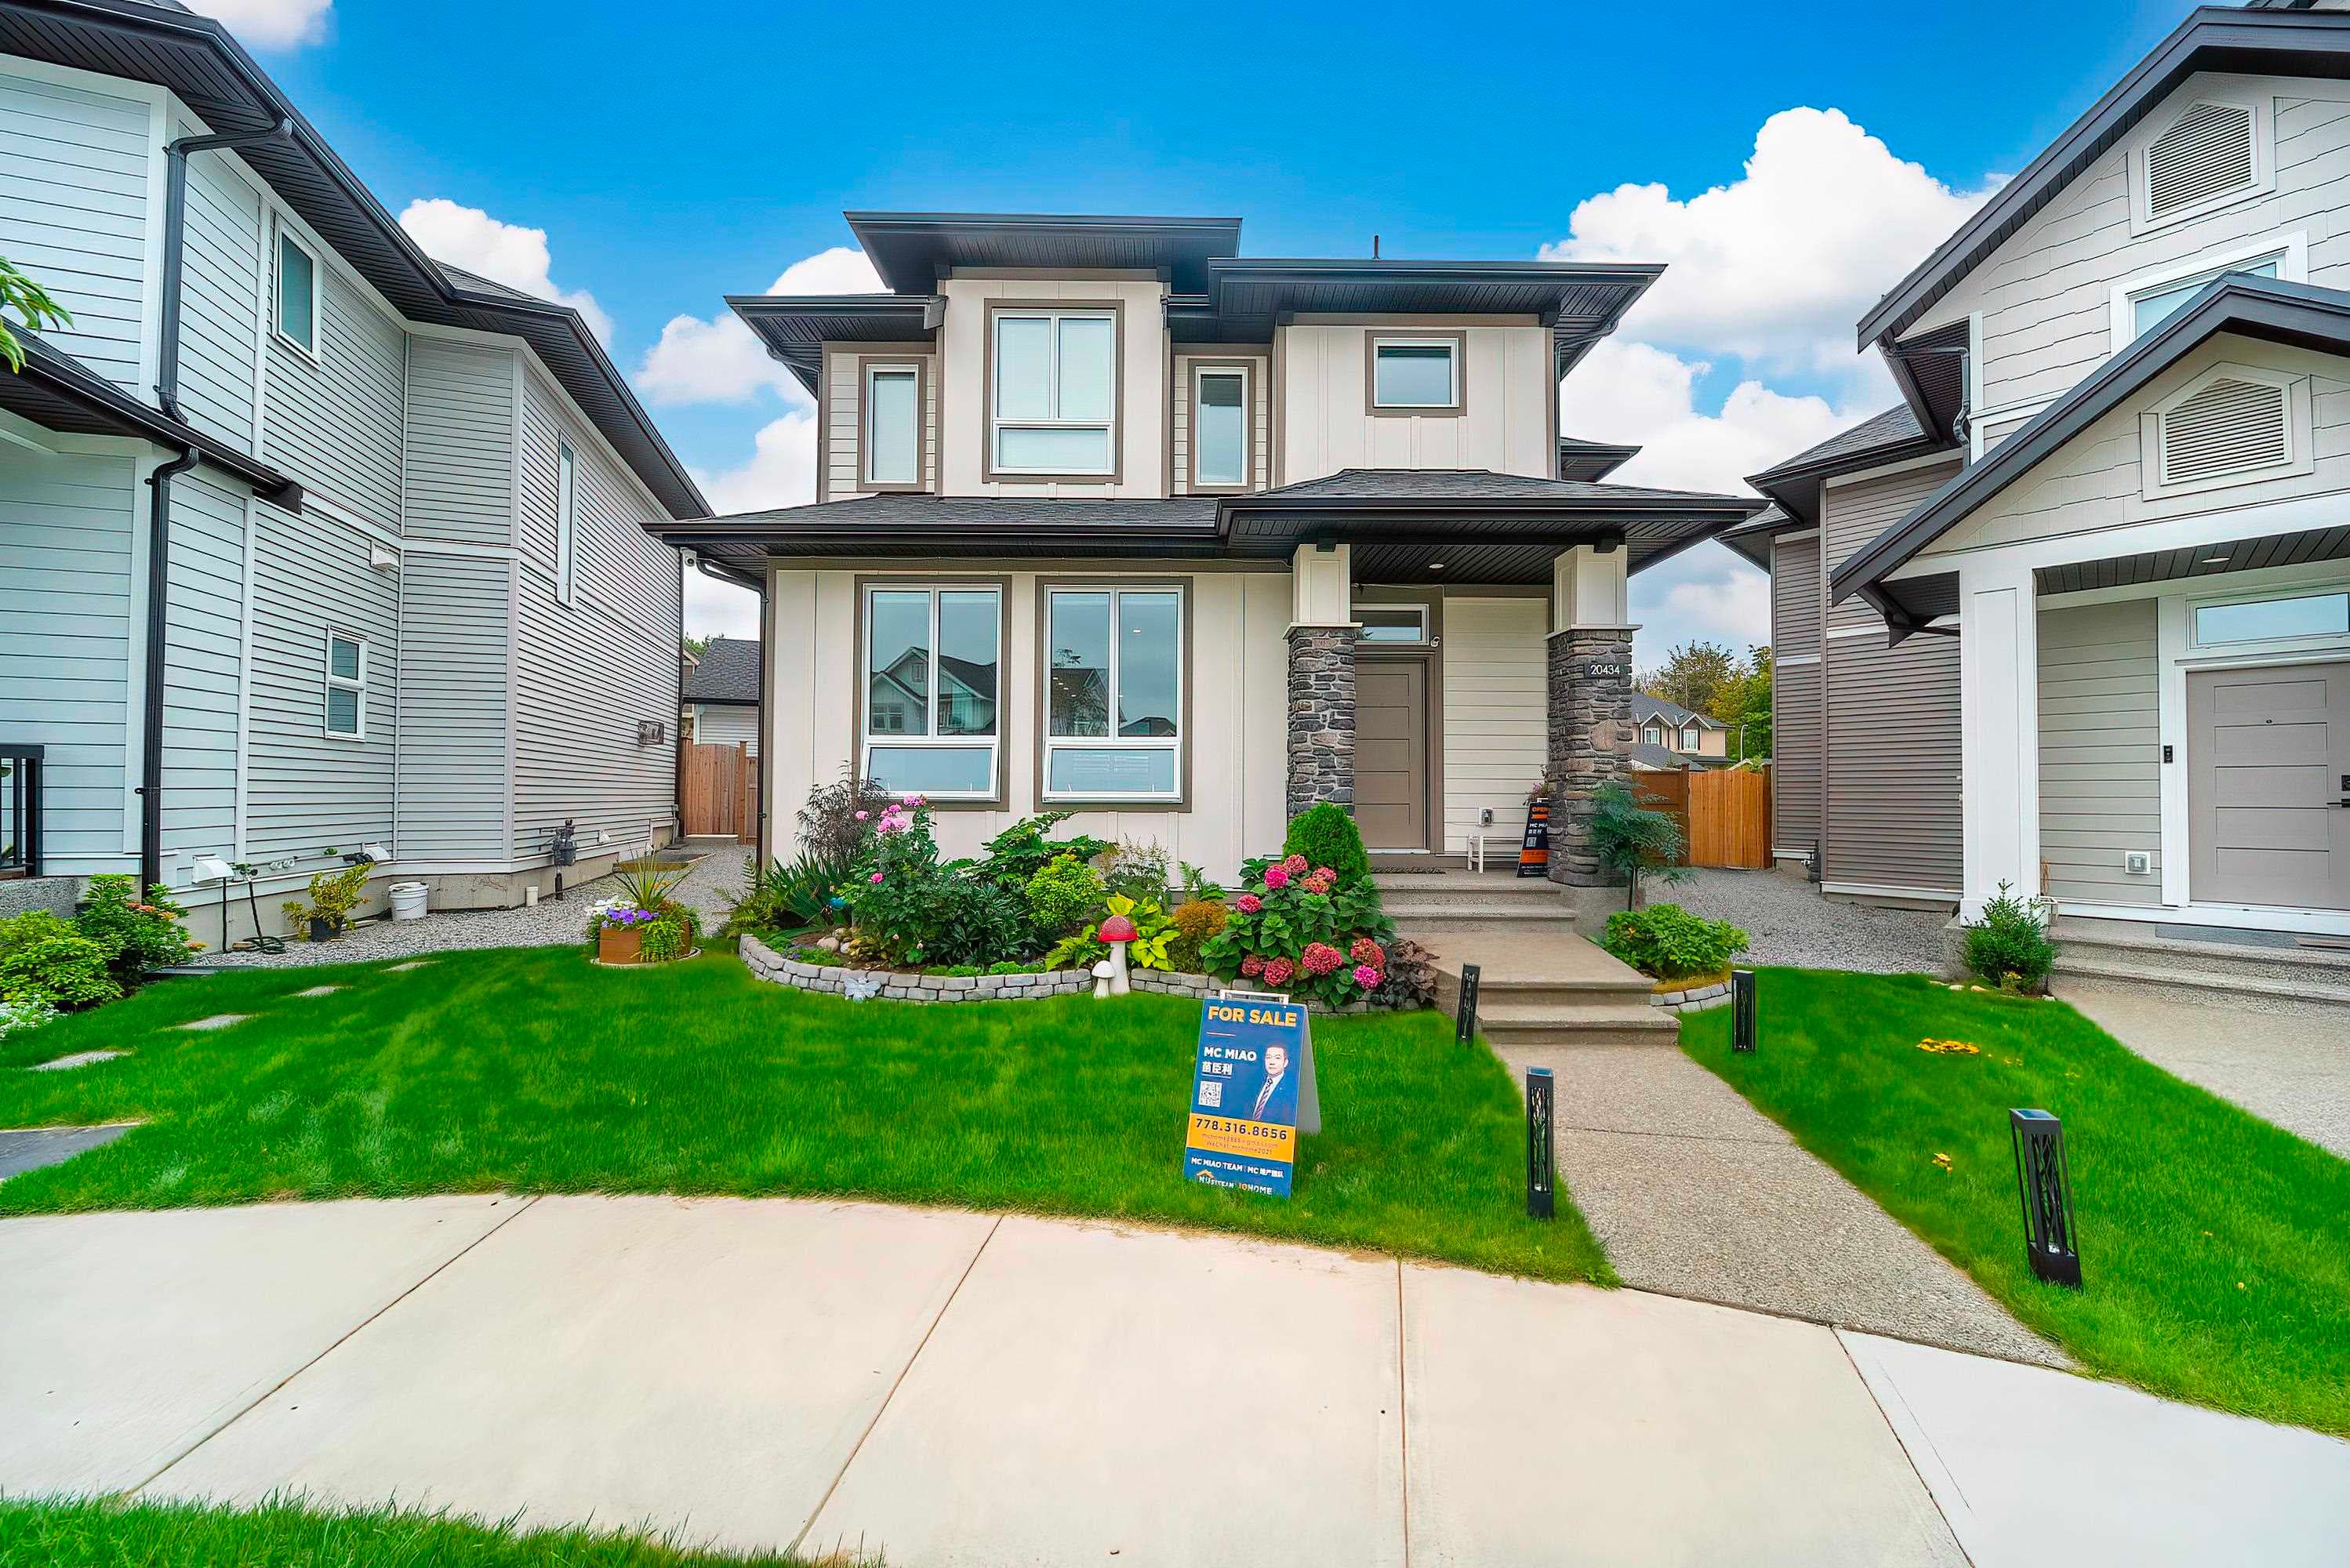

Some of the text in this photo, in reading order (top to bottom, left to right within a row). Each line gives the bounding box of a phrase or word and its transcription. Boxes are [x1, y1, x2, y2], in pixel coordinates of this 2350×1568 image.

[1590, 664, 1620, 675] 20434
[1208, 1006, 1298, 1028] FOR SALE
[1204, 1047, 1258, 1062] MC MIAO
[1196, 1118, 1287, 1140] 778.316.8656
[1191, 1156, 1243, 1171] MC MIAO TEAM
[1248, 1166, 1259, 1175] MC
